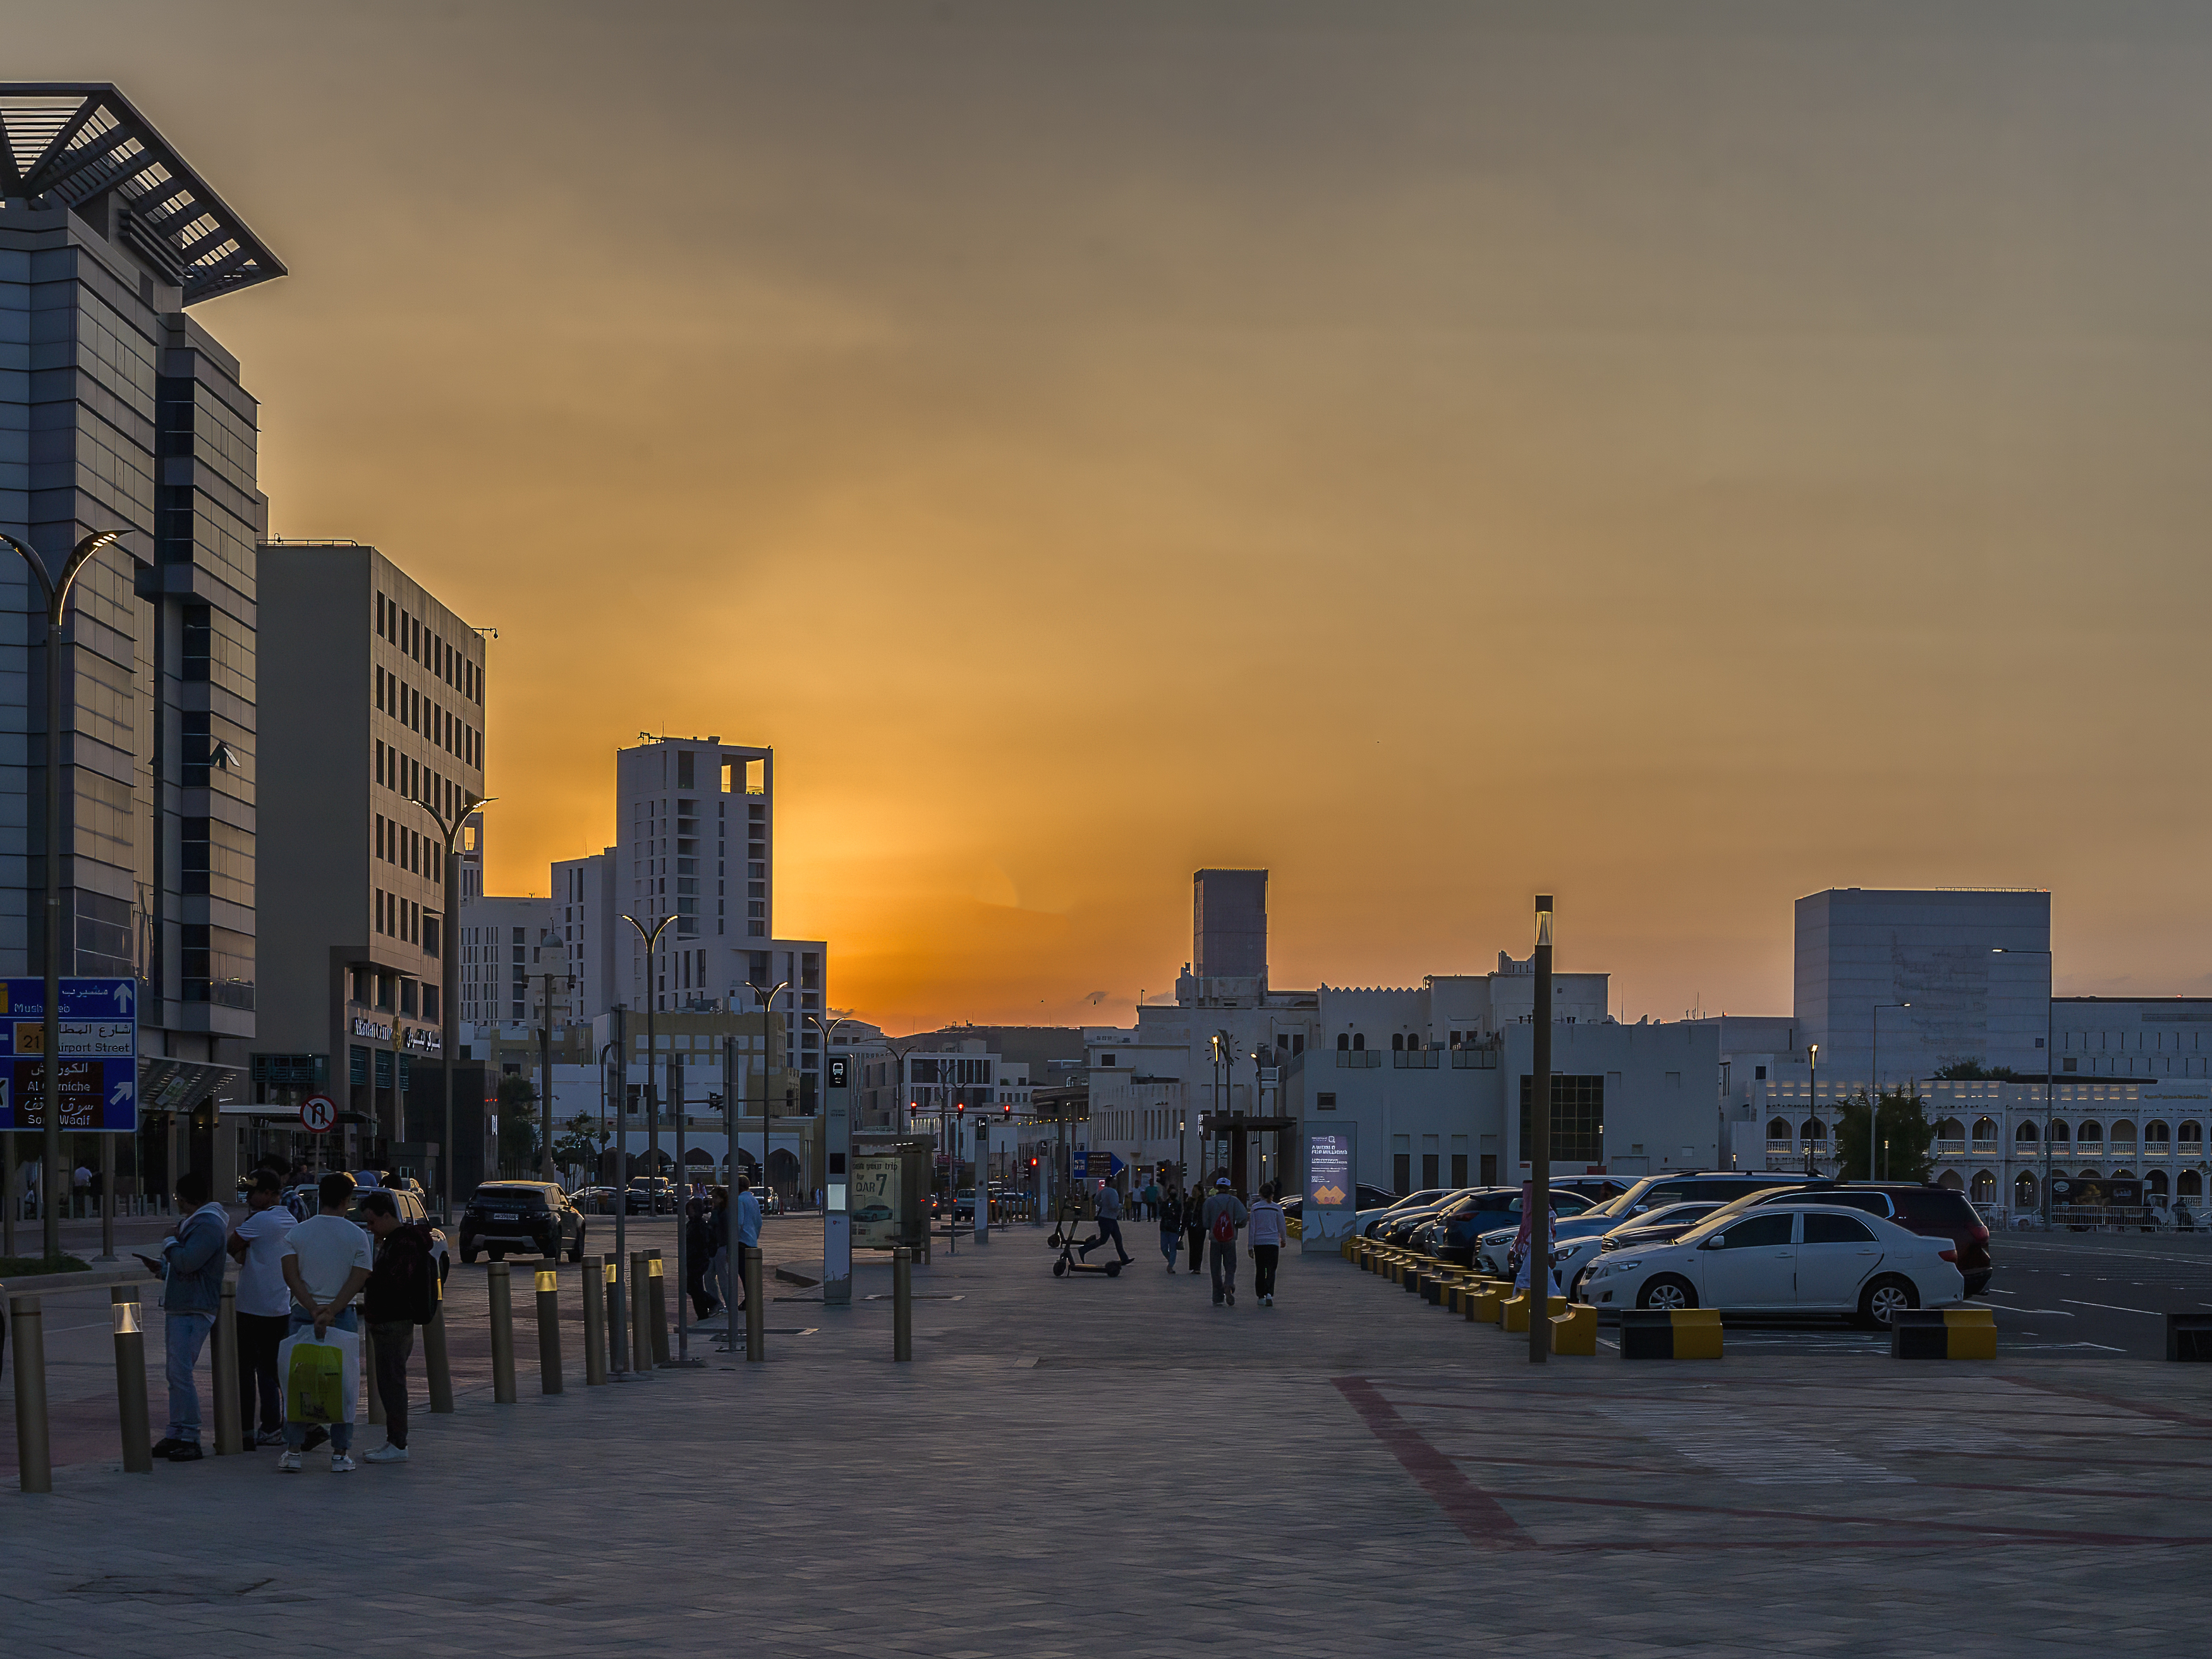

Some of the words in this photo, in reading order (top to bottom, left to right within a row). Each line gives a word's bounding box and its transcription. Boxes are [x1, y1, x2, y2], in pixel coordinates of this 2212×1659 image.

[59, 1024, 92, 1034] المطا
[99, 1024, 131, 1037] شارع
[23, 1035, 39, 1049] 21
[95, 1043, 130, 1052] Street
[28, 1081, 39, 1091] Al
[59, 1115, 90, 1126] Waqif
[885, 1162, 898, 1171] trip
[856, 1182, 875, 1192] QAR
[876, 1174, 887, 1196] 7
